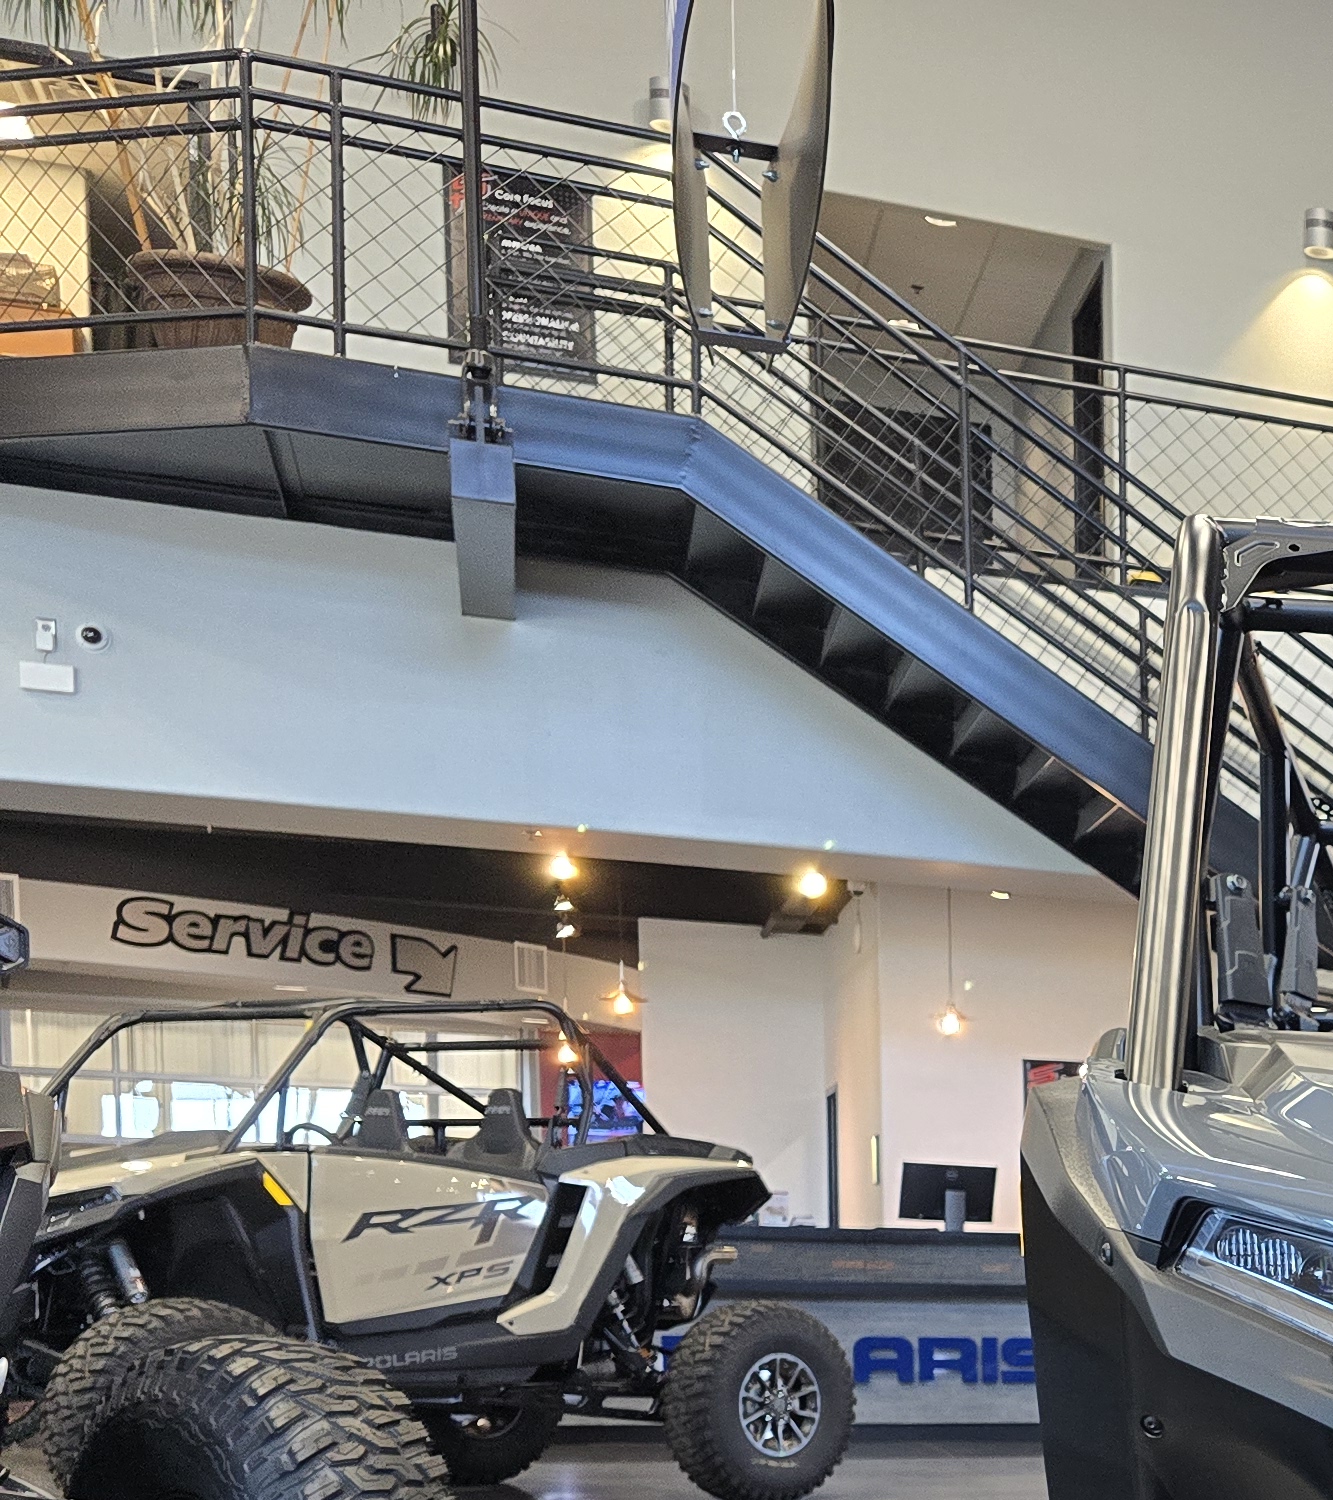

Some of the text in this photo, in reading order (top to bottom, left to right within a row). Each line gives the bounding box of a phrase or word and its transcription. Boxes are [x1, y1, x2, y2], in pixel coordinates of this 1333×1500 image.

[111, 896, 375, 971] Service
[341, 1195, 539, 1246] RZR
[424, 1259, 515, 1291] XPS
